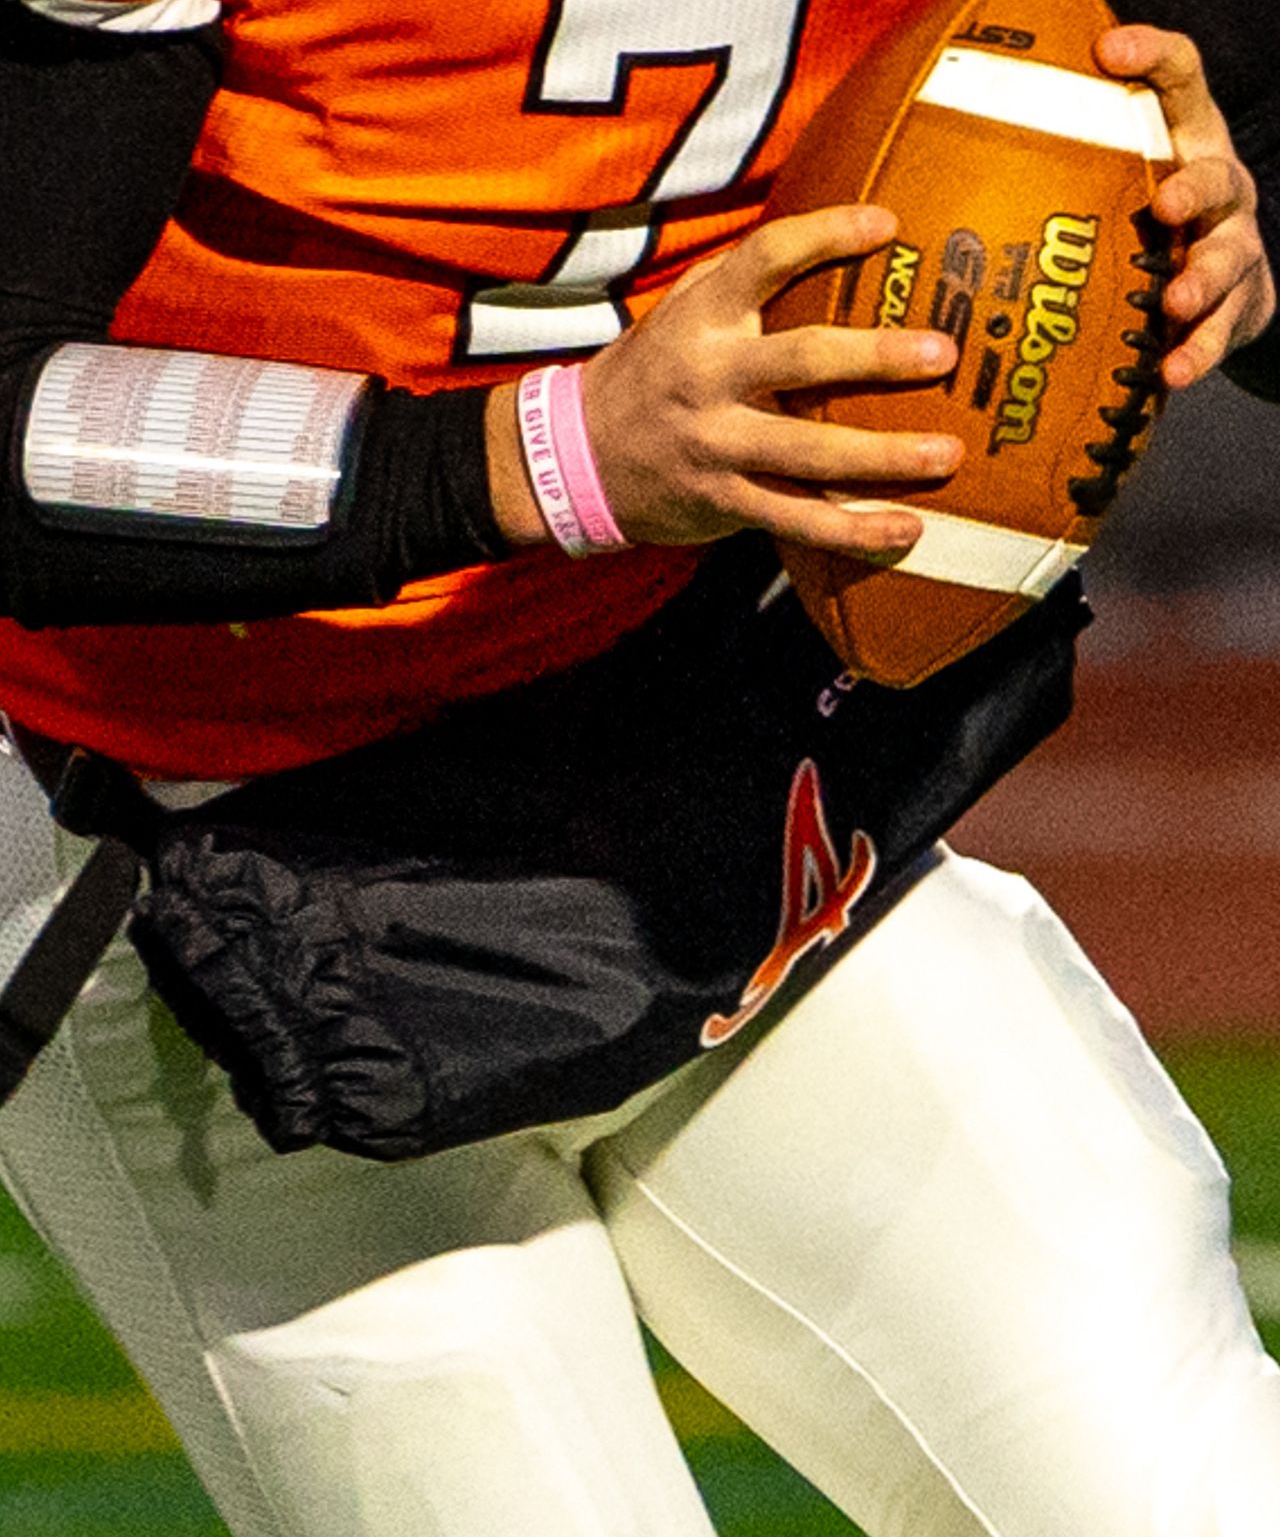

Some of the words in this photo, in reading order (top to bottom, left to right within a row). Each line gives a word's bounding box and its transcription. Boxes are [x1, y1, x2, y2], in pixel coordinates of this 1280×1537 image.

[987, 212, 1101, 456] Wilson
[523, 407, 553, 464] GIVE
[536, 469, 564, 502] UP
